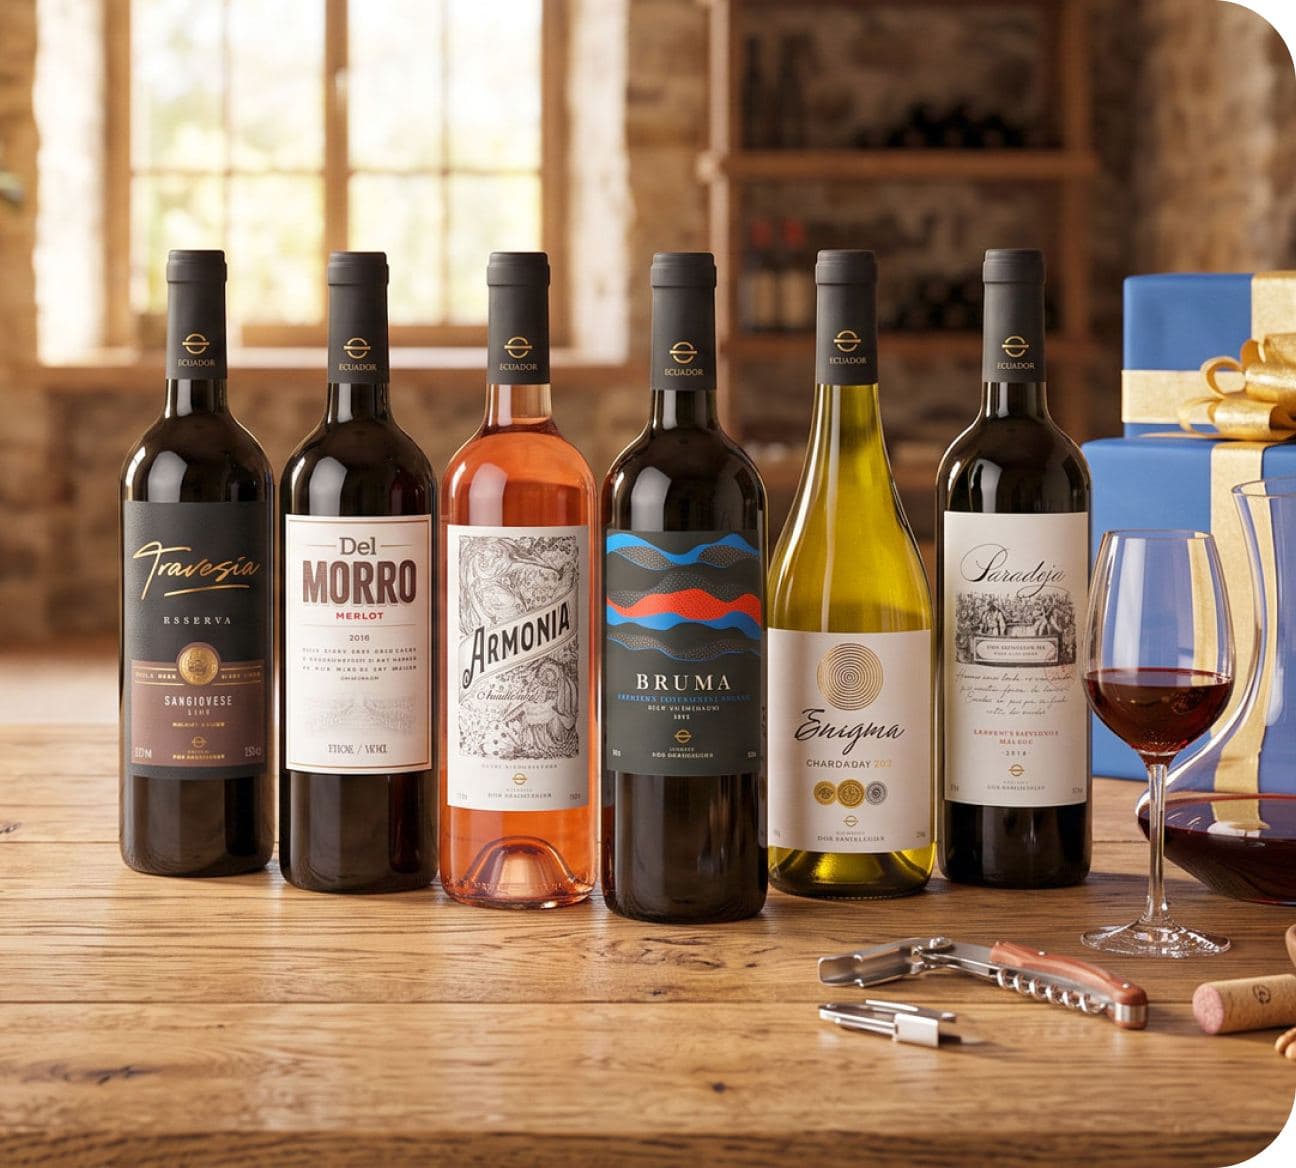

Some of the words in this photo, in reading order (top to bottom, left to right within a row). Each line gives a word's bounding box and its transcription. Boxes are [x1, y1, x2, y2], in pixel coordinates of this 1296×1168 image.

[177, 359, 216, 368] ECUADOR
[829, 356, 867, 366] ECUADOR
[997, 362, 1035, 370] ECUADOR
[338, 363, 377, 372] ECUADOR
[499, 363, 538, 372] ECUADOR
[664, 368, 704, 377] ECUADOR
[339, 536, 376, 555] Del
[302, 559, 417, 605] MORRO
[335, 611, 384, 620] MERLOT
[462, 601, 570, 690] ARMONIA
[635, 673, 732, 691] BRUMA
[164, 695, 233, 707] SANGIOVESE
[794, 708, 905, 755] Enigma
